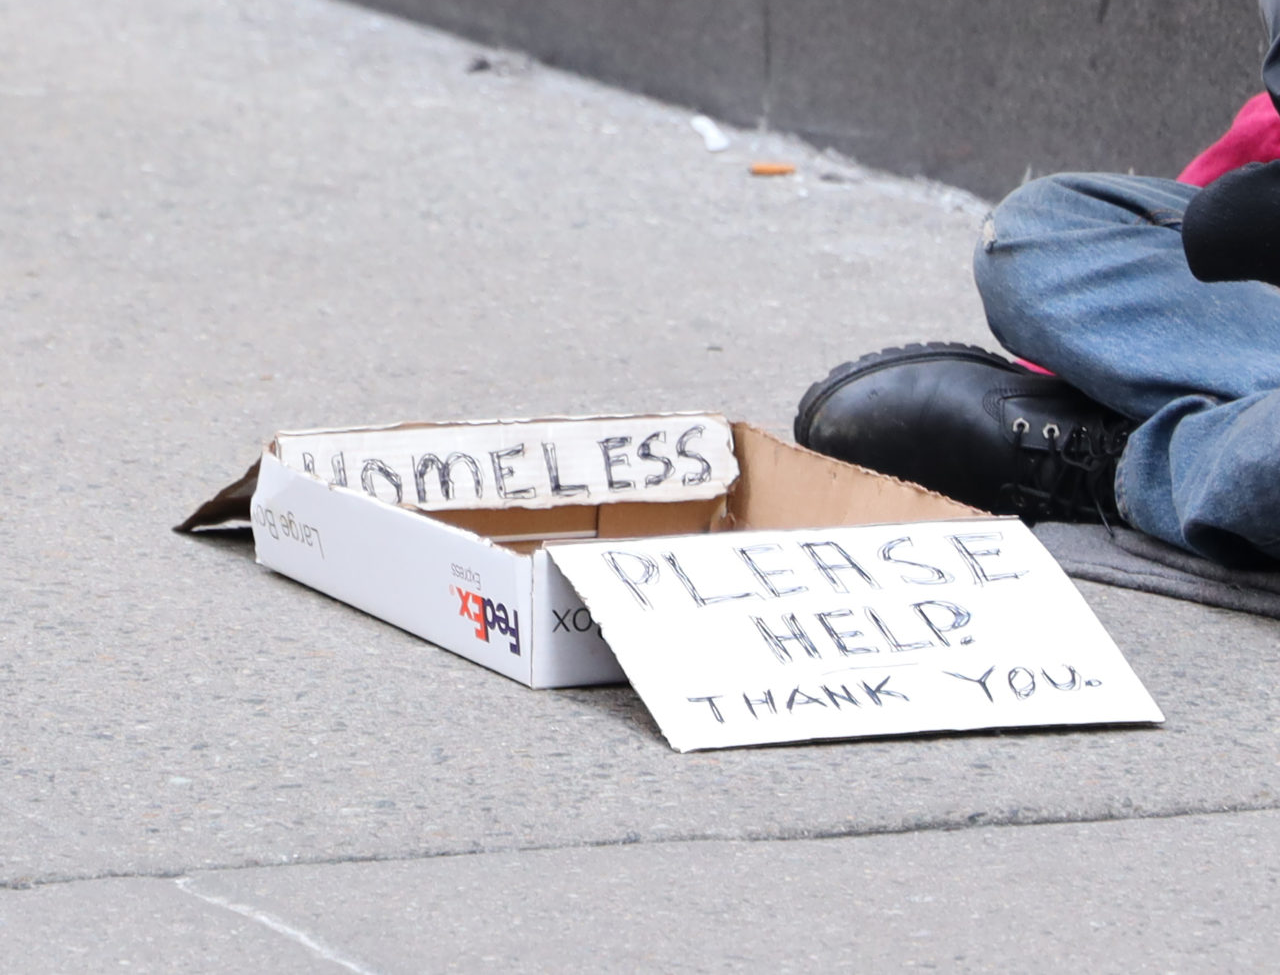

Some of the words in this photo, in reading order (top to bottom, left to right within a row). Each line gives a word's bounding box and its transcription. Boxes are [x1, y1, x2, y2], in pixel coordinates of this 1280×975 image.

[280, 510, 325, 561] Large
[450, 563, 482, 591] Express
[601, 532, 1030, 611] PLEASE
[455, 585, 521, 657] FedEx
[552, 607, 604, 641] ox
[686, 676, 910, 724] THANK
[942, 664, 1103, 703] YOU.
